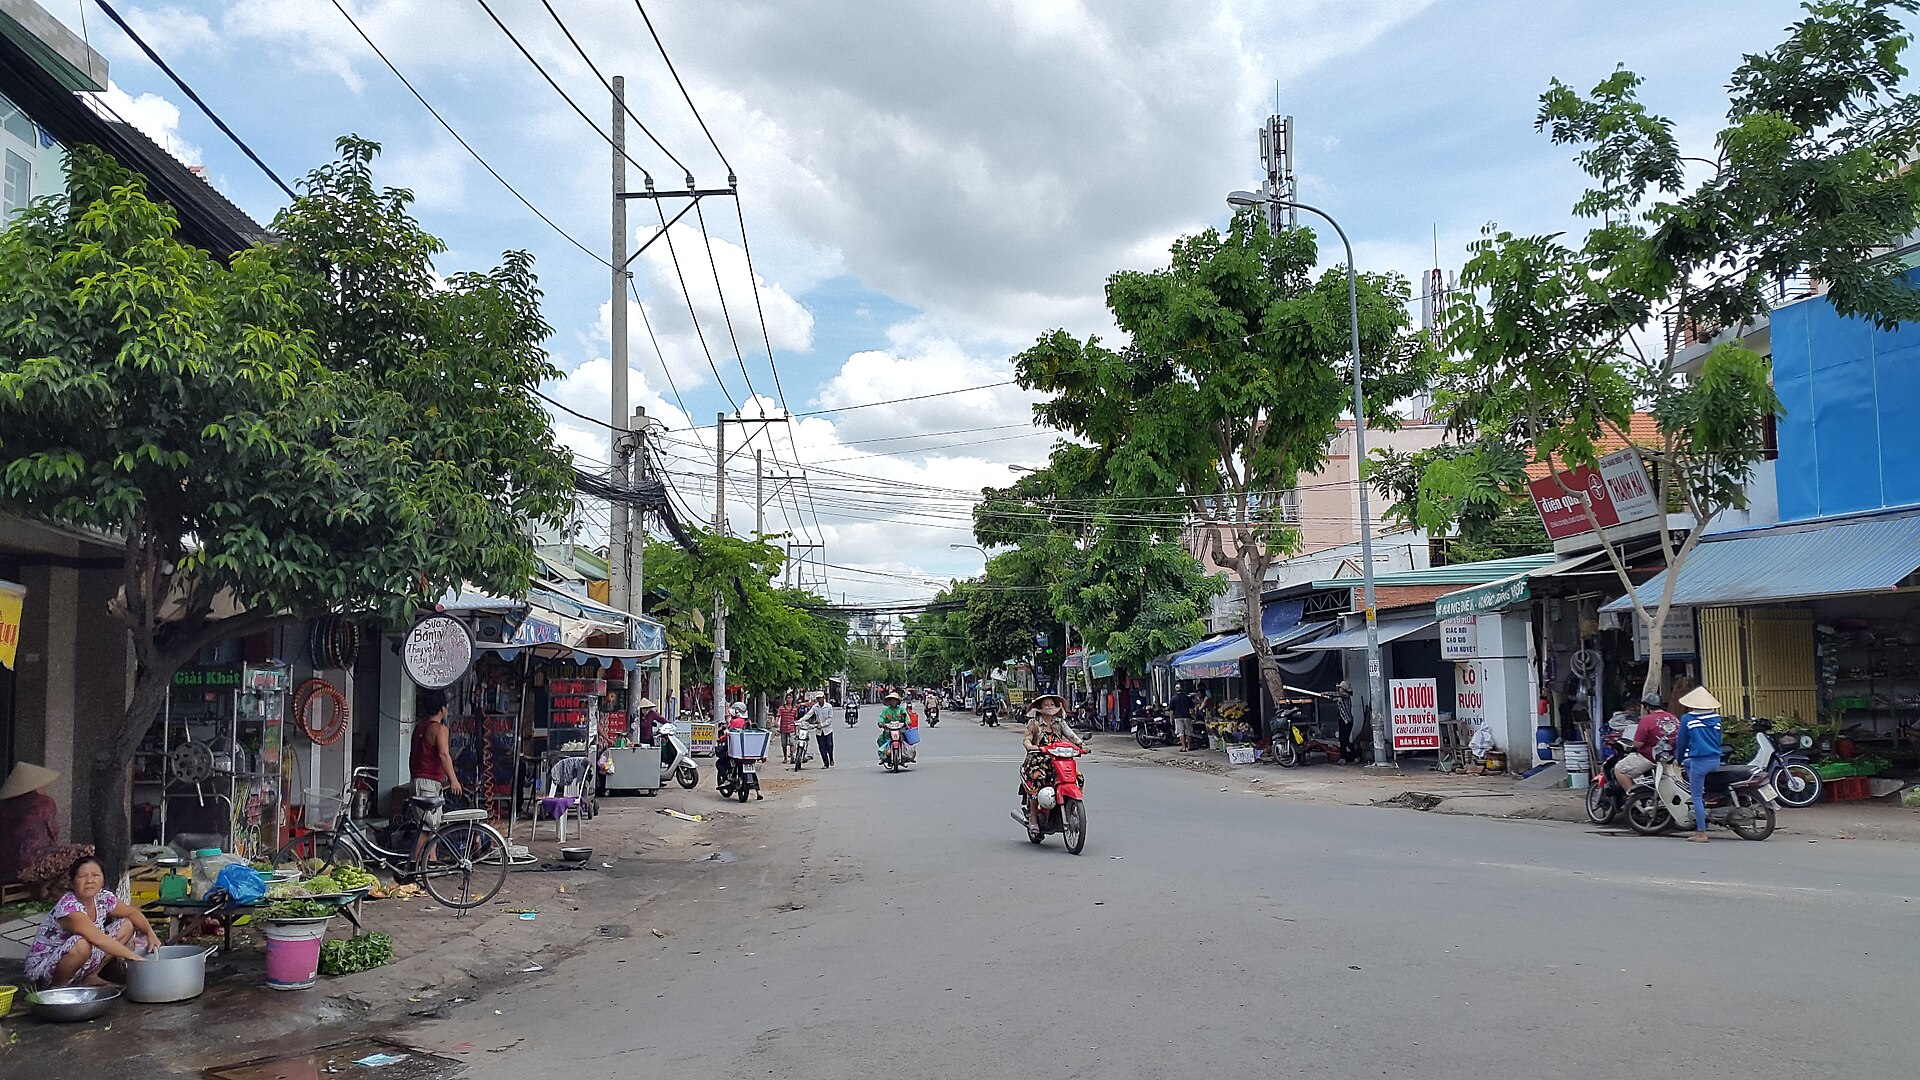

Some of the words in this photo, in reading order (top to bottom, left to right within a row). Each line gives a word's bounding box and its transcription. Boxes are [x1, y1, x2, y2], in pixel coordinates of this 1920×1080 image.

[1607, 473, 1635, 503] THANH
[1538, 496, 1563, 514] điện
[1562, 490, 1592, 513] quag
[175, 670, 202, 684] Giải
[206, 669, 240, 684] Khát
[1463, 664, 1476, 684] LÒ
[1393, 682, 1406, 709] LÒ
[1407, 683, 1434, 712] RƯỢU
[1458, 690, 1482, 713] RƯỢU
[1394, 714, 1407, 724] GIA
